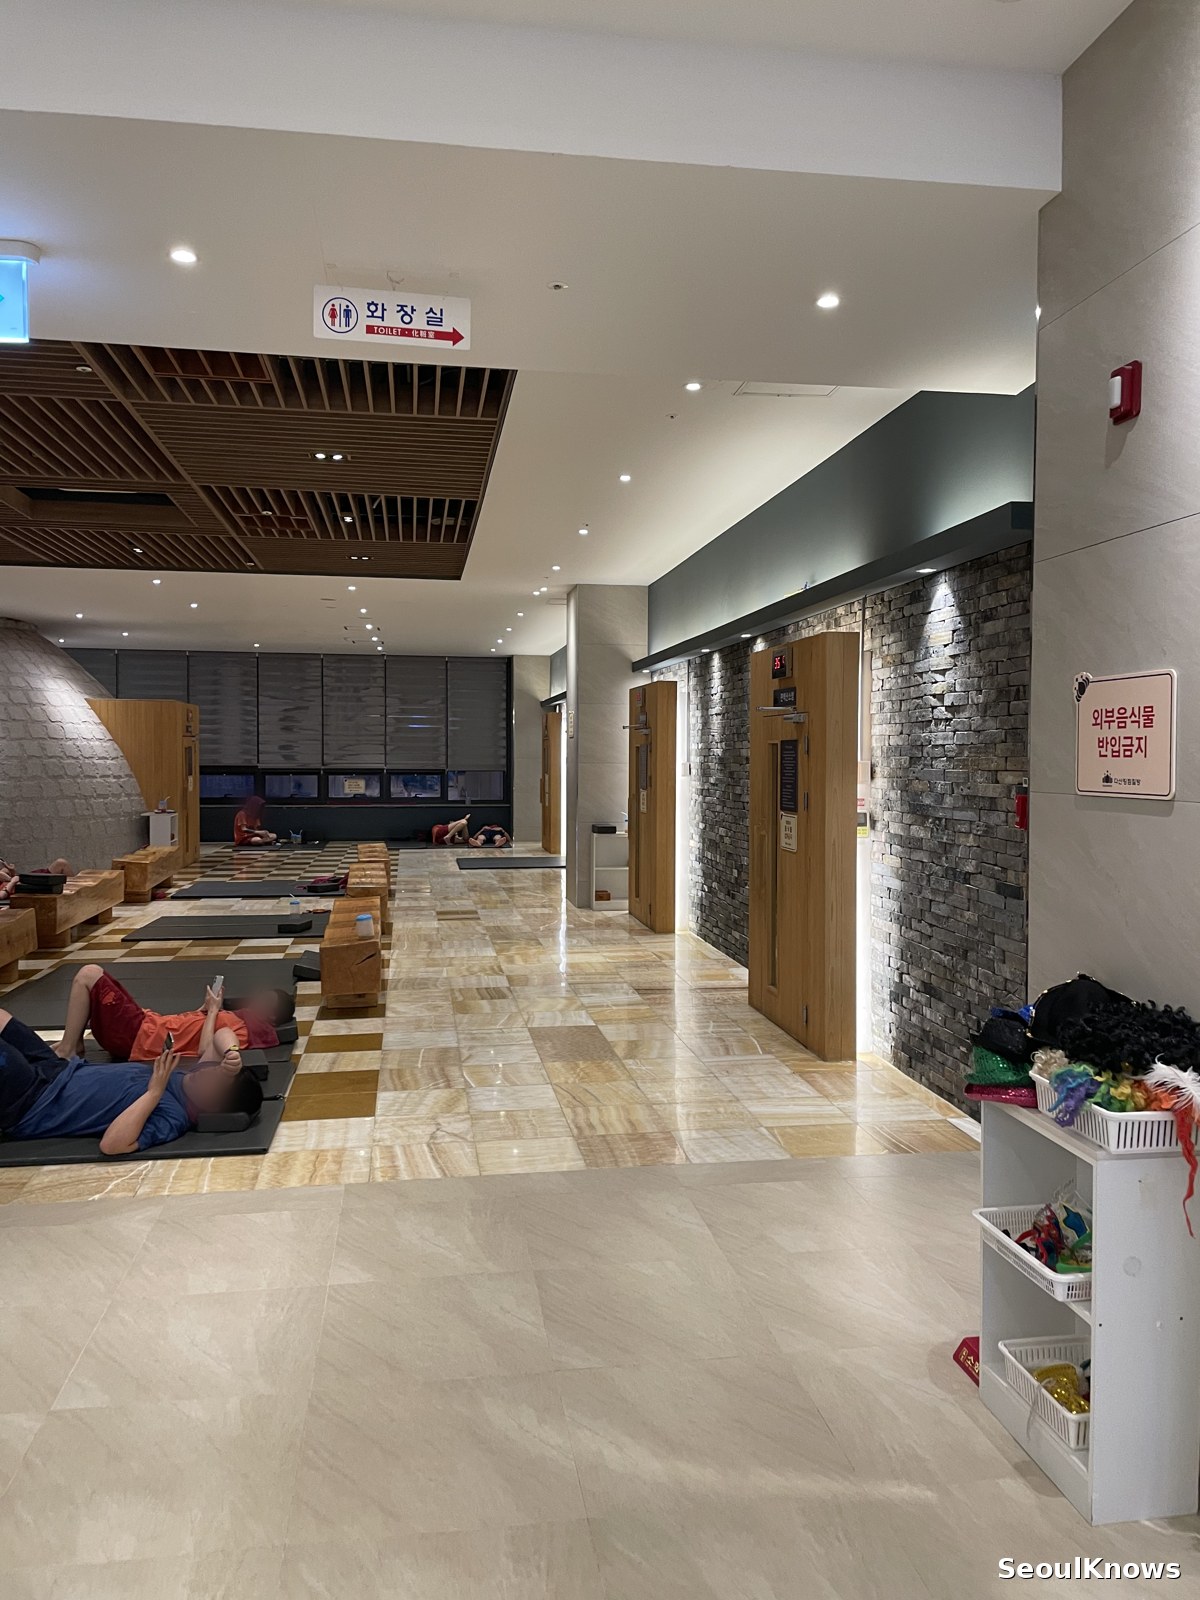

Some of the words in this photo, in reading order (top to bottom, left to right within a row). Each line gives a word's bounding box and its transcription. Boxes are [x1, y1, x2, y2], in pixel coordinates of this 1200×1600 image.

[366, 301, 444, 327] 화장실
[373, 326, 402, 336] TOILET
[1091, 705, 1155, 730] 외부음식물
[1097, 735, 1147, 759] 반입금지
